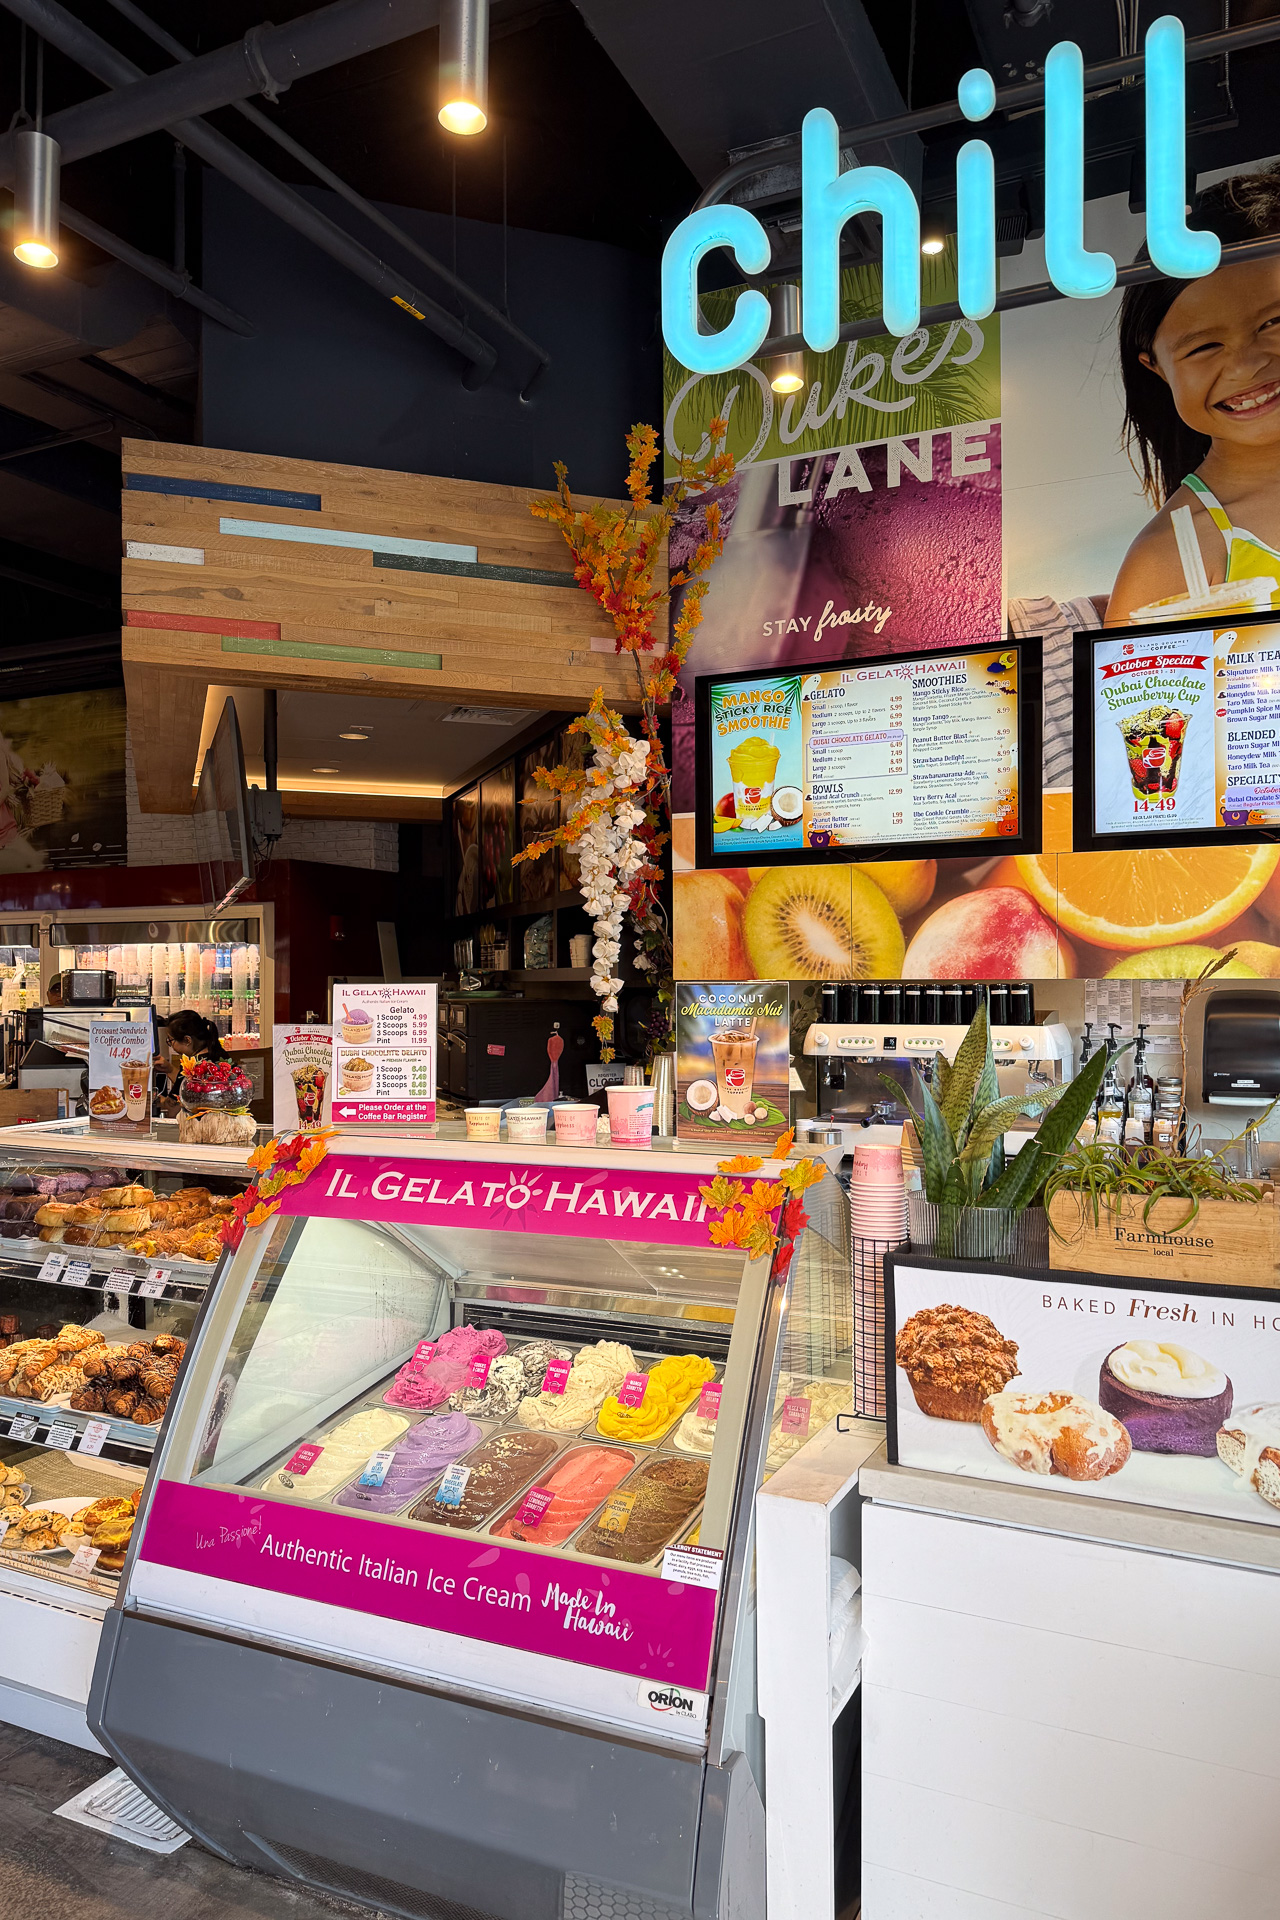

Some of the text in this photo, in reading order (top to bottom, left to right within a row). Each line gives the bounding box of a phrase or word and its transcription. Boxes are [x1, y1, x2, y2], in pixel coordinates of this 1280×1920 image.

[661, 14, 1222, 375] chill
[778, 423, 992, 507] LANE
[762, 600, 893, 642] STAY frosty
[1111, 656, 1196, 673] October Special
[1227, 652, 1255, 665] MILK
[842, 661, 966, 683] IL GELATO HAWAII
[912, 674, 967, 689] SMOOTHIES
[1100, 676, 1206, 699] Dubai Chocolate
[722, 690, 785, 709] MANGO
[810, 688, 845, 700] GELATO
[1107, 689, 1200, 711] Strawberry Cup
[715, 705, 792, 722] STICKY RICE
[717, 715, 790, 736] SMOOTHIE
[1227, 729, 1276, 742] BLENDED
[812, 783, 843, 794] BOWLS
[1134, 798, 1176, 812] 14.49
[352, 988, 390, 997] GELATO
[699, 994, 764, 1003] COCONUT
[389, 1006, 414, 1014] Gelato
[681, 1000, 783, 1018] Macadamia Nut
[381, 1013, 403, 1021] Scoop
[714, 1017, 751, 1027] LATTE
[91, 1026, 148, 1035] Croissant Sandwich
[382, 1021, 408, 1029] Scoops
[290, 1035, 309, 1043] October
[382, 1029, 408, 1037] Scoops
[100, 1036, 120, 1046] Coffee
[121, 1036, 145, 1045] Combo
[109, 1047, 131, 1059] 14.49
[283, 1046, 304, 1058] Dubai
[285, 1055, 321, 1066] Strawberry
[380, 1066, 402, 1074] Scoop
[382, 1073, 407, 1081] Scoops
[382, 1081, 407, 1089] Scoops
[397, 1113, 427, 1121] Register
[298, 1120, 321, 1130] 14.49
[325, 1168, 708, 1223] IL GELATO HAWAII
[1114, 1227, 1214, 1249] Farmhouse
[1153, 1247, 1174, 1257] local
[1042, 1294, 1116, 1315] BAKED
[1127, 1298, 1199, 1324] Fresh
[1212, 1311, 1235, 1327] IN
[527, 1497, 547, 1507] LEMONADE
[529, 1490, 552, 1503] STRAWBERRY
[525, 1502, 543, 1513] SORBETTO
[606, 1504, 631, 1514] CHOCOLATE
[196, 1515, 262, 1550] Una Passione!
[691, 1547, 723, 1558] STATEMENT
[260, 1534, 531, 1613] Authentic Italian Ice Cream
[541, 1582, 616, 1618] Made In
[563, 1606, 635, 1642] Hawaii
[648, 1688, 693, 1711] ORION
